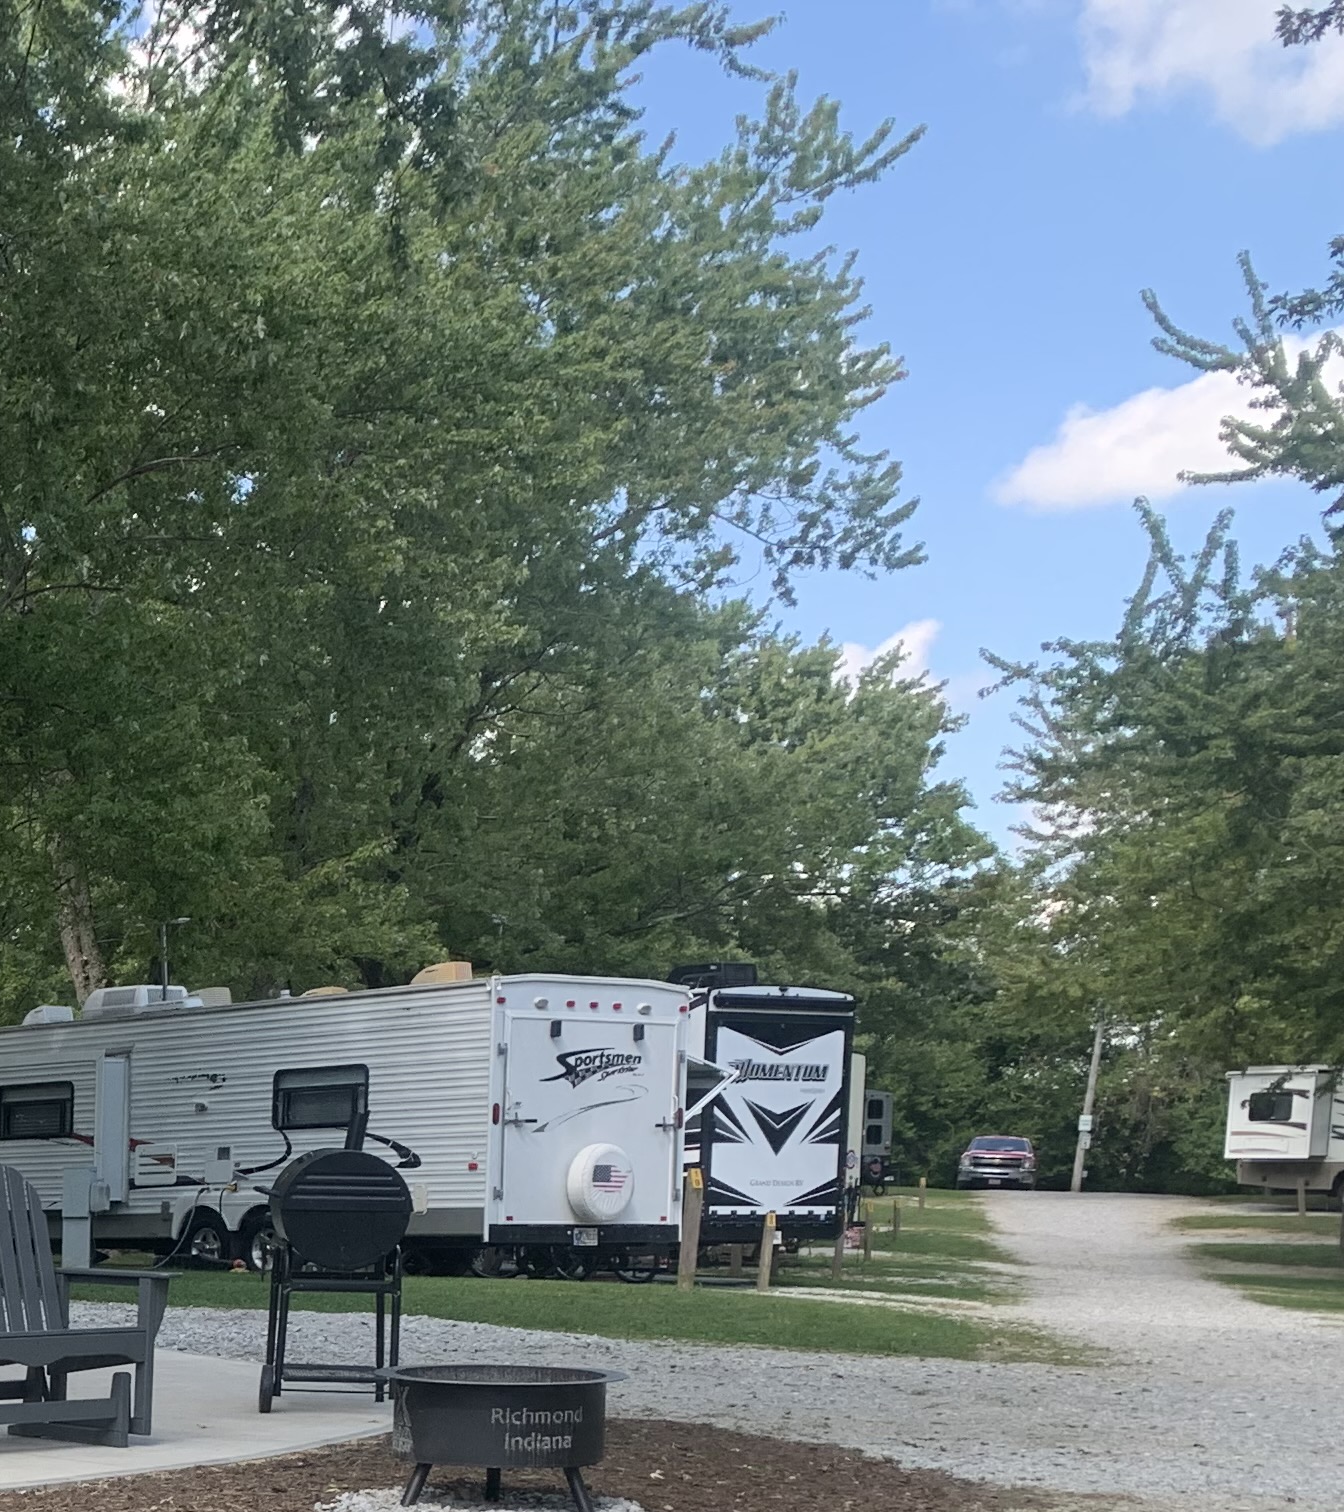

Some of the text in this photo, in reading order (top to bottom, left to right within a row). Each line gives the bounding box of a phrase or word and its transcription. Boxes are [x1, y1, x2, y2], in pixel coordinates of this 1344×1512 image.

[539, 1048, 642, 1082] Sportsmen
[728, 1059, 829, 1084] MOMENTUM
[491, 1405, 583, 1425] Richmond
[504, 1432, 572, 1450] Indiana
